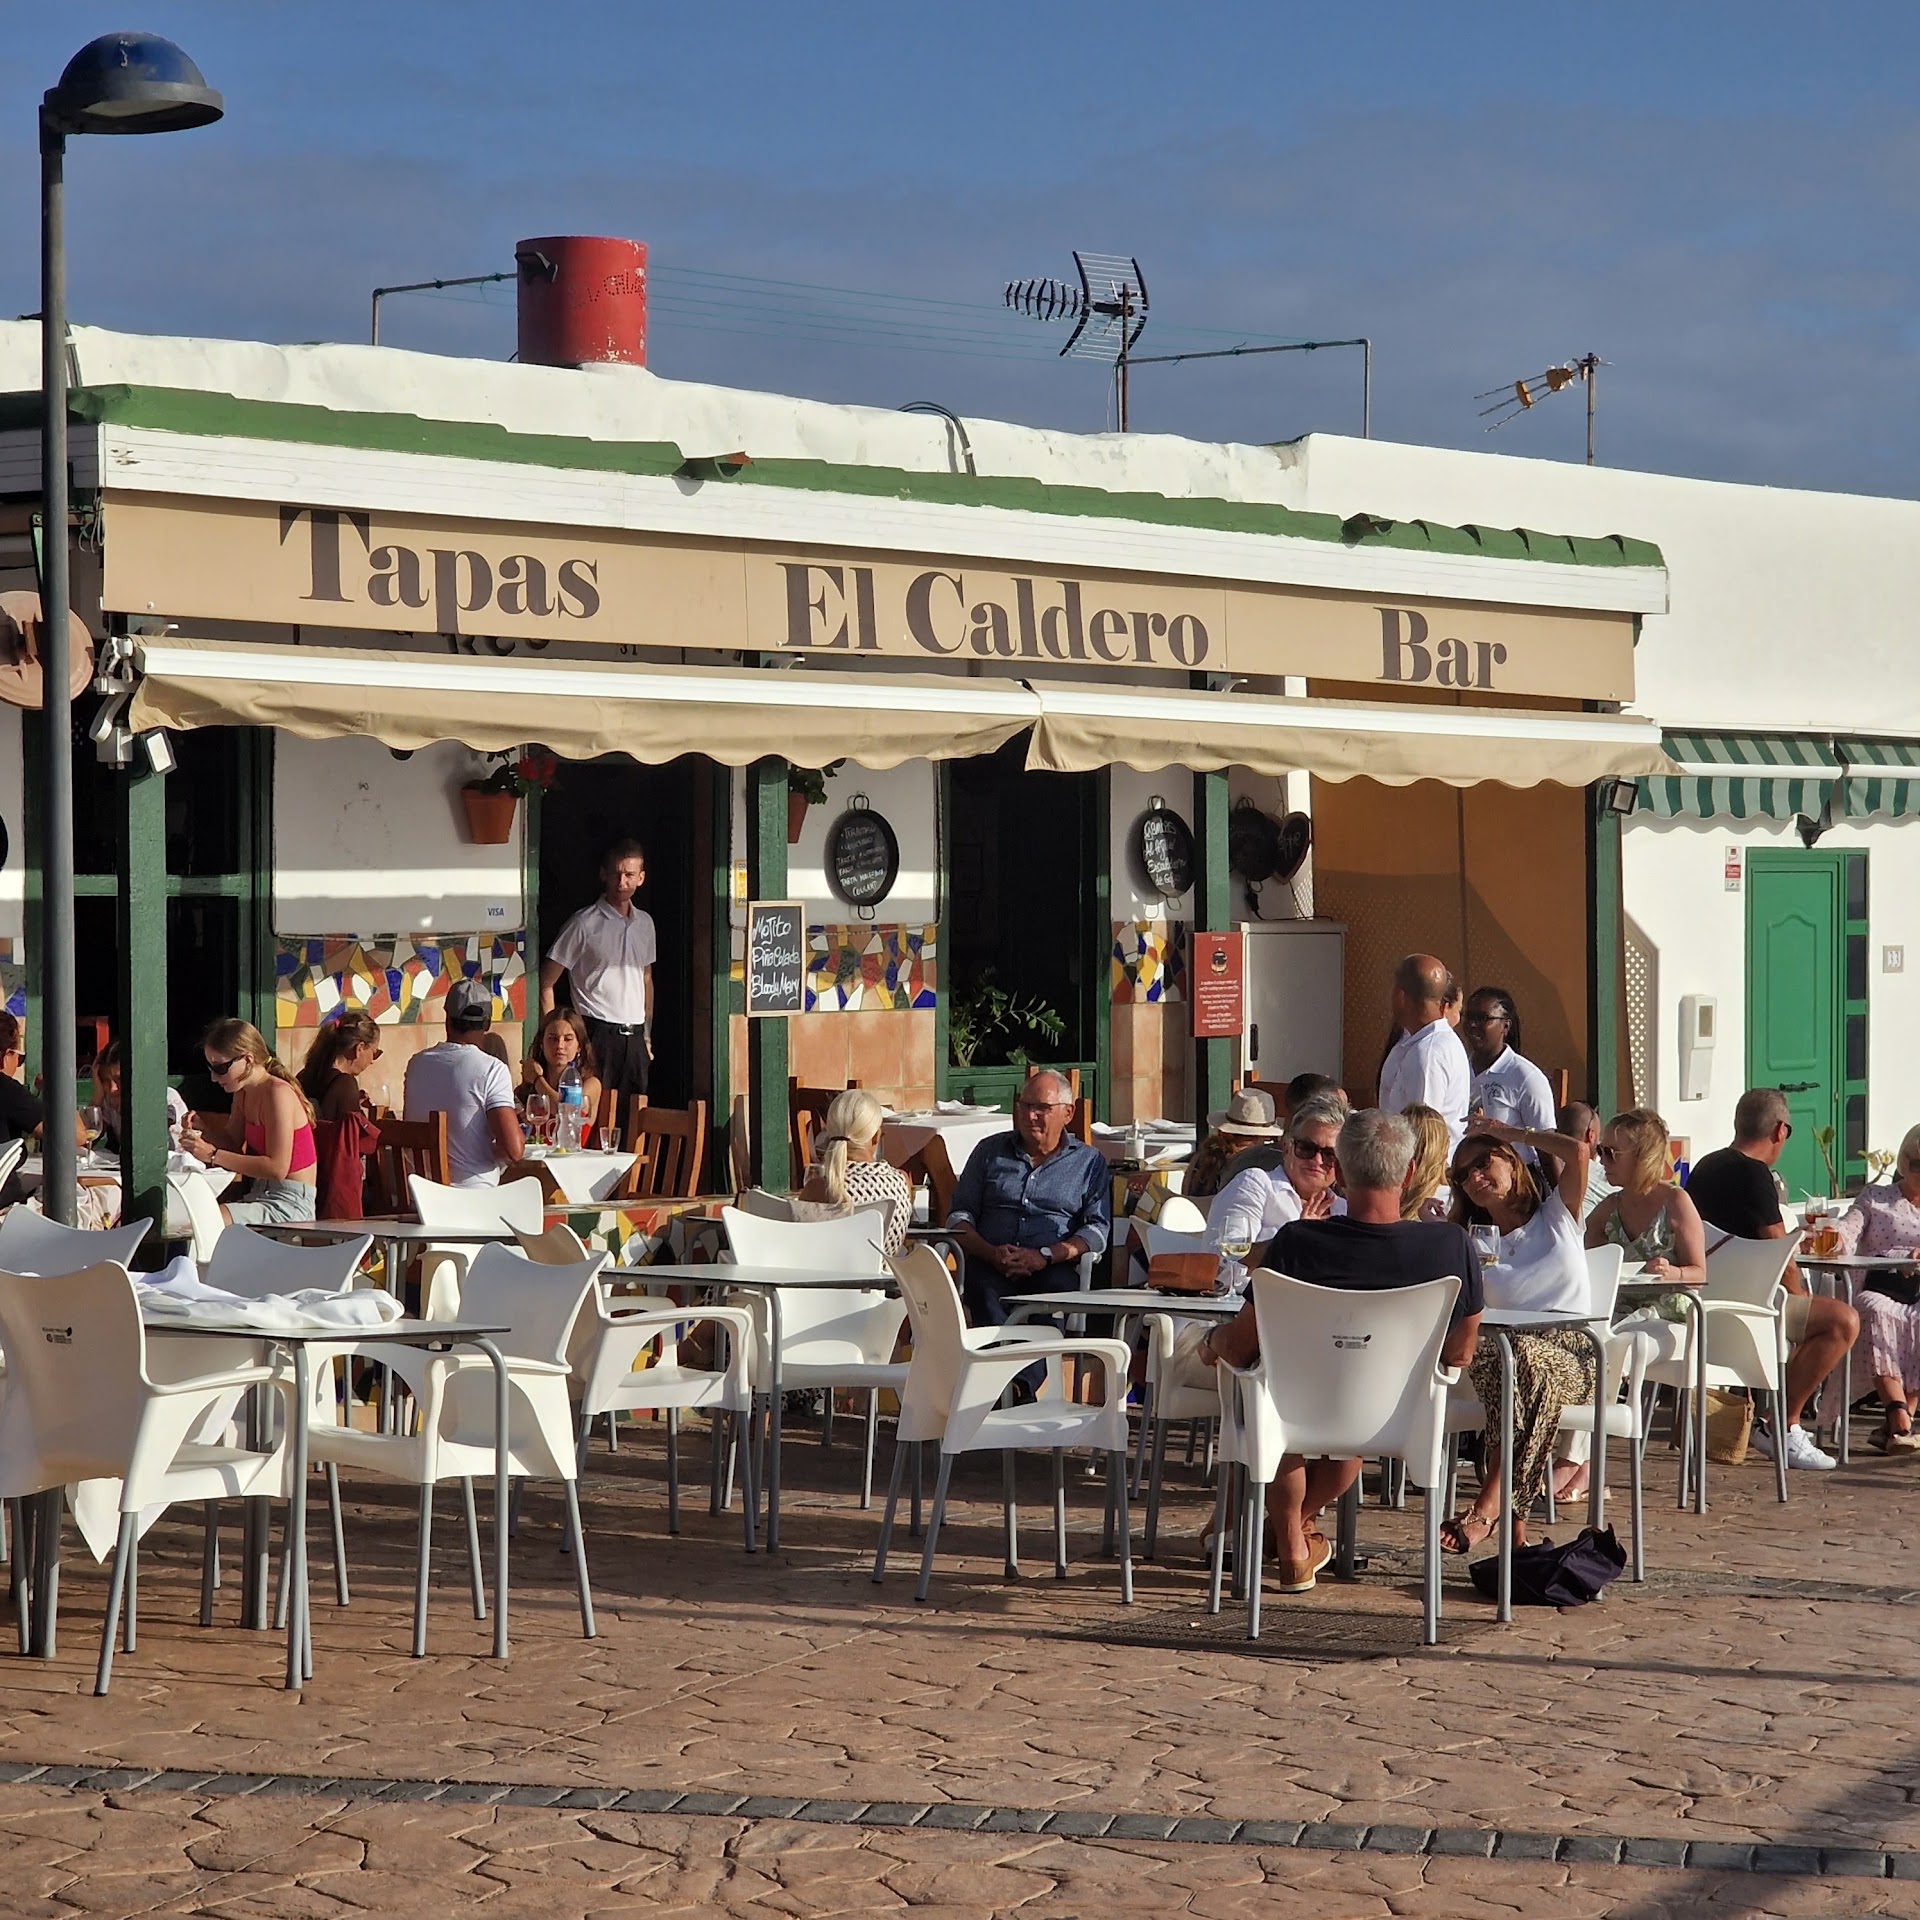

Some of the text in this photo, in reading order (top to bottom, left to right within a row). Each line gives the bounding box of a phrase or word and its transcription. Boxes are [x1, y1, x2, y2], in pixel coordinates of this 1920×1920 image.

[280, 505, 1507, 689] Tapas El Caldero Bar
[487, 907, 504, 916] VISA
[773, 944, 800, 967] Colada
[751, 972, 800, 1005] Bloody Mary
